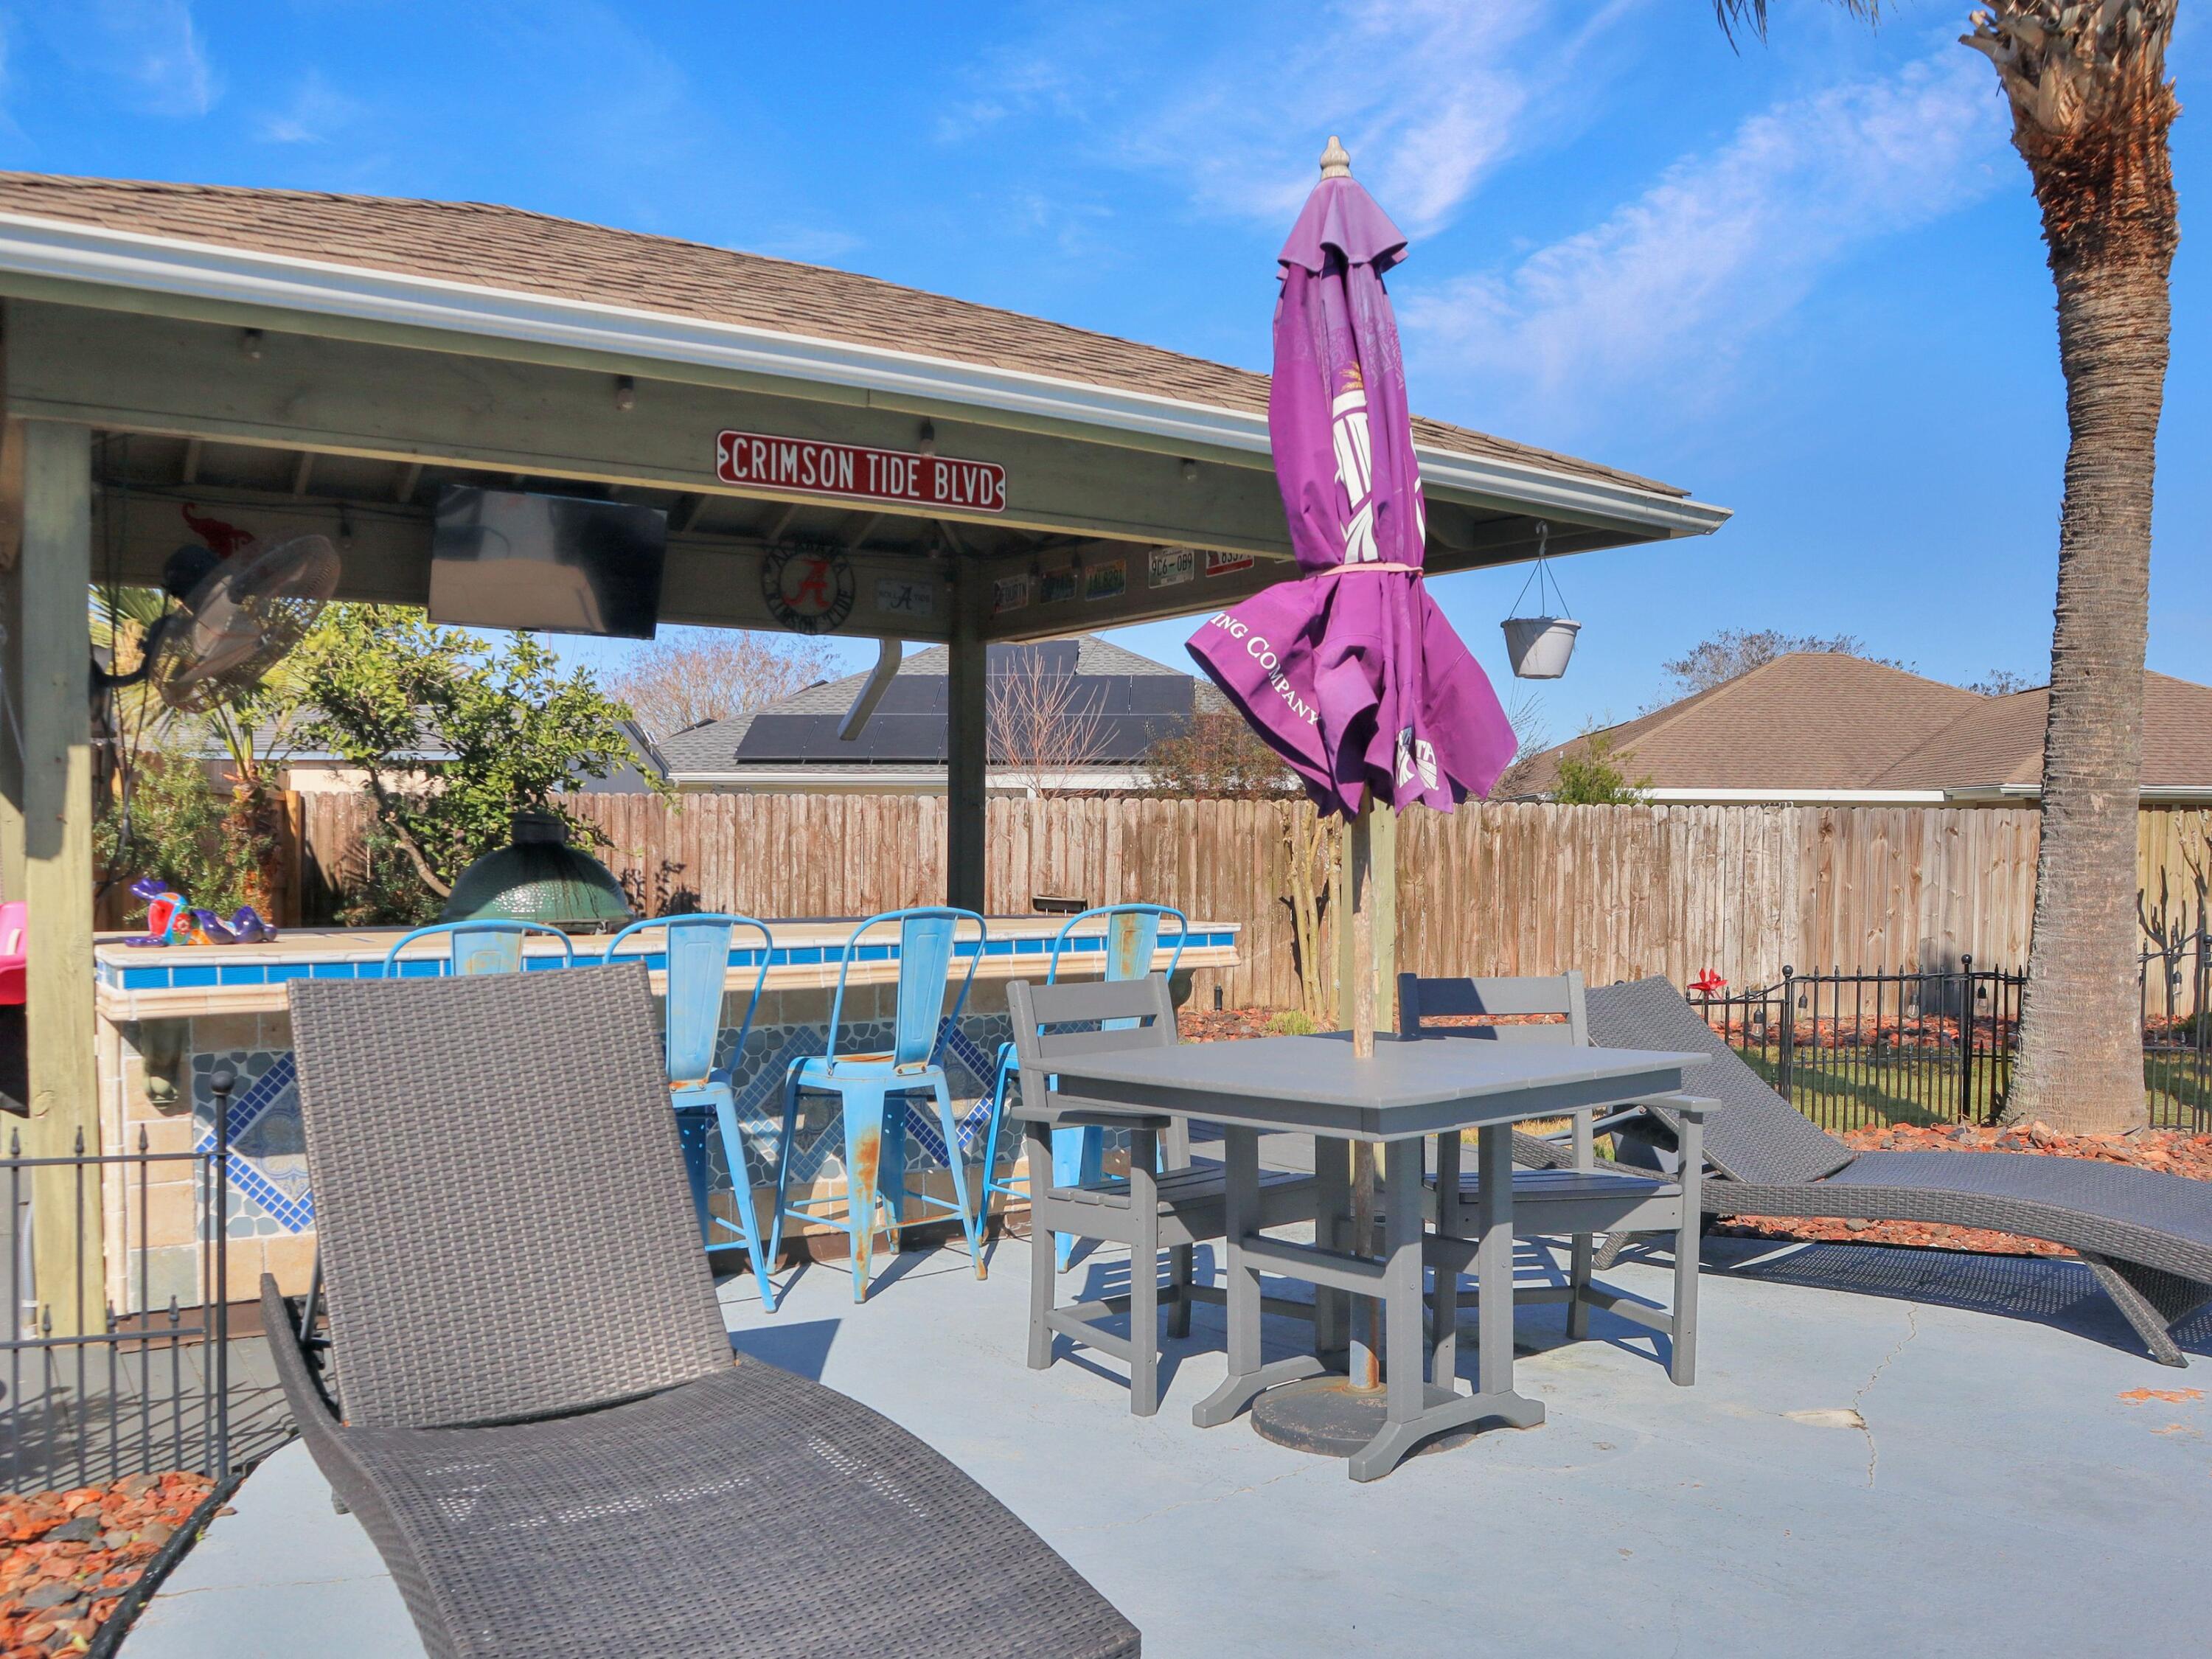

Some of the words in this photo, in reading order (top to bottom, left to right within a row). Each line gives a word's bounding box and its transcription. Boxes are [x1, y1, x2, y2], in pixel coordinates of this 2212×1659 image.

[732, 437, 855, 490] CRIMSON
[866, 453, 920, 497] TIDE
[934, 462, 993, 505] BLVD
[1211, 613, 1248, 639] ING
[1247, 636, 1319, 726] COMPANY
